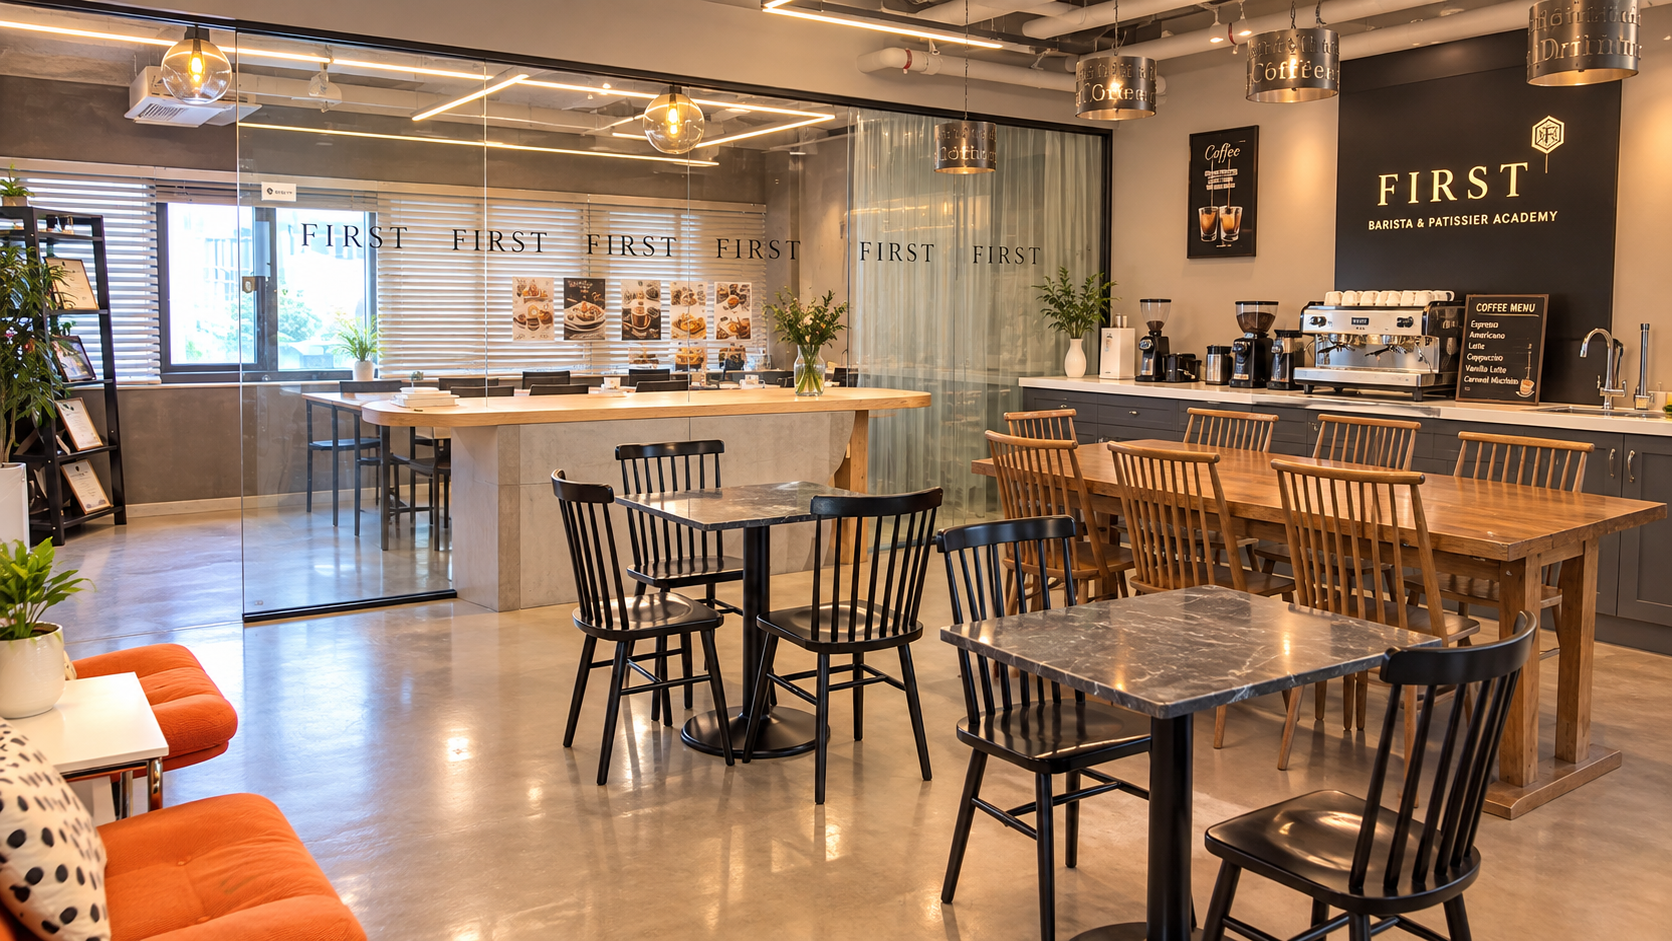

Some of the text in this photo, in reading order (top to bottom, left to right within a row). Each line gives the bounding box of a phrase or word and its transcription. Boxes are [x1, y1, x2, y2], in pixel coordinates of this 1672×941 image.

[1204, 142, 1241, 164] Coffee
[1377, 161, 1529, 207] FIRST
[1368, 210, 1559, 231] BARISTA & PATISSIER ACADEMY
[302, 222, 1041, 266] FIRST FIRST FIRST FIRST FIRST FIRST
[1475, 302, 1536, 313] COFFEE MENU
